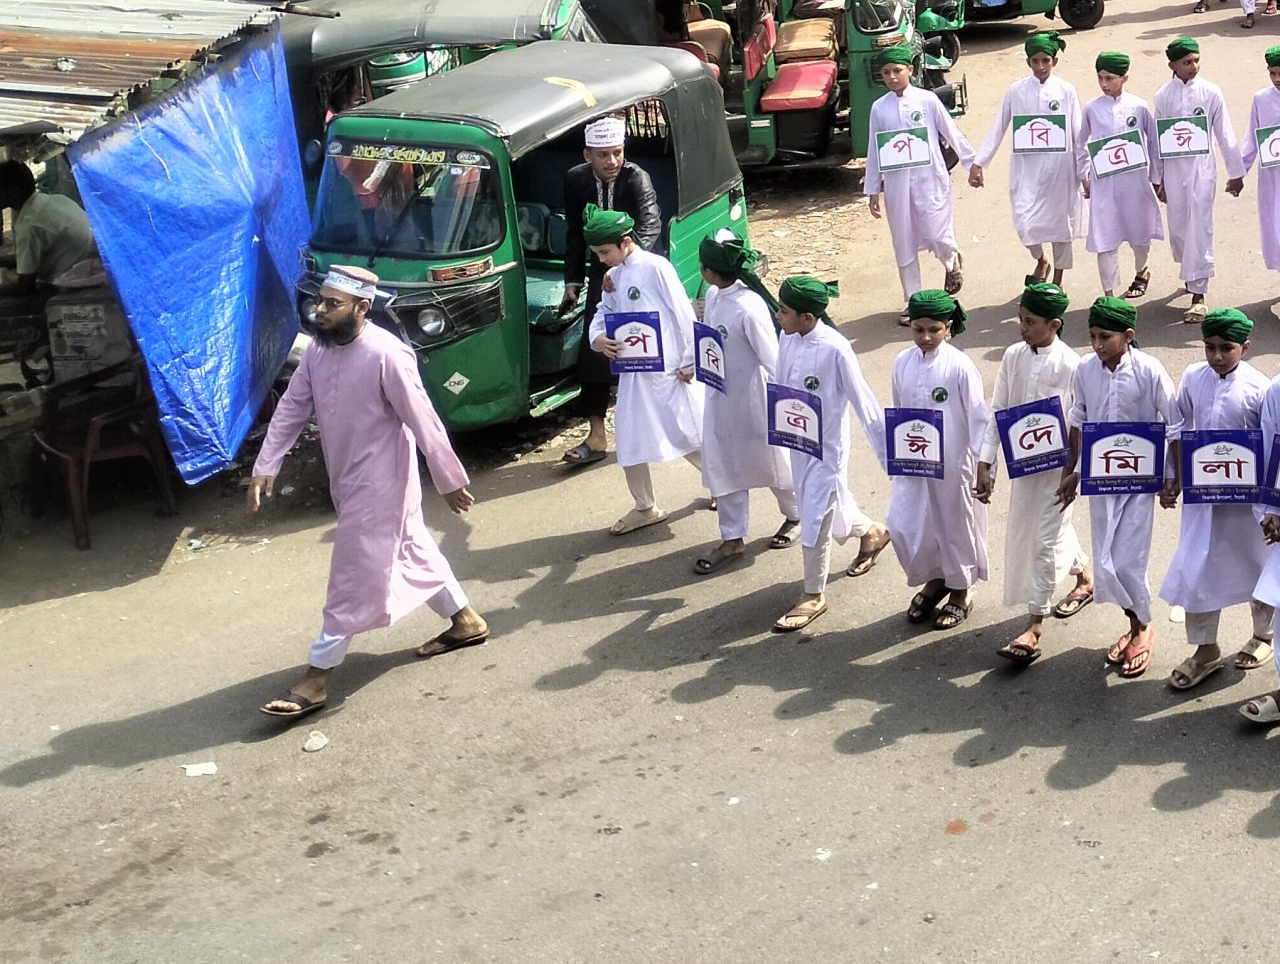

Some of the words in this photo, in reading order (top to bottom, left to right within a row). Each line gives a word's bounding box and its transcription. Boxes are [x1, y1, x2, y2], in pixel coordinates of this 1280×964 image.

[1028, 121, 1051, 147] বি
[1173, 127, 1195, 154] ঈ
[893, 137, 915, 161] প
[1104, 143, 1130, 166] ত্র
[624, 332, 652, 354] প
[705, 348, 721, 373] বি
[784, 410, 811, 433] ত্র
[903, 433, 932, 459] ঈ
[1018, 424, 1057, 451] দে
[1097, 449, 1148, 475] মি
[1197, 458, 1249, 479] লা
